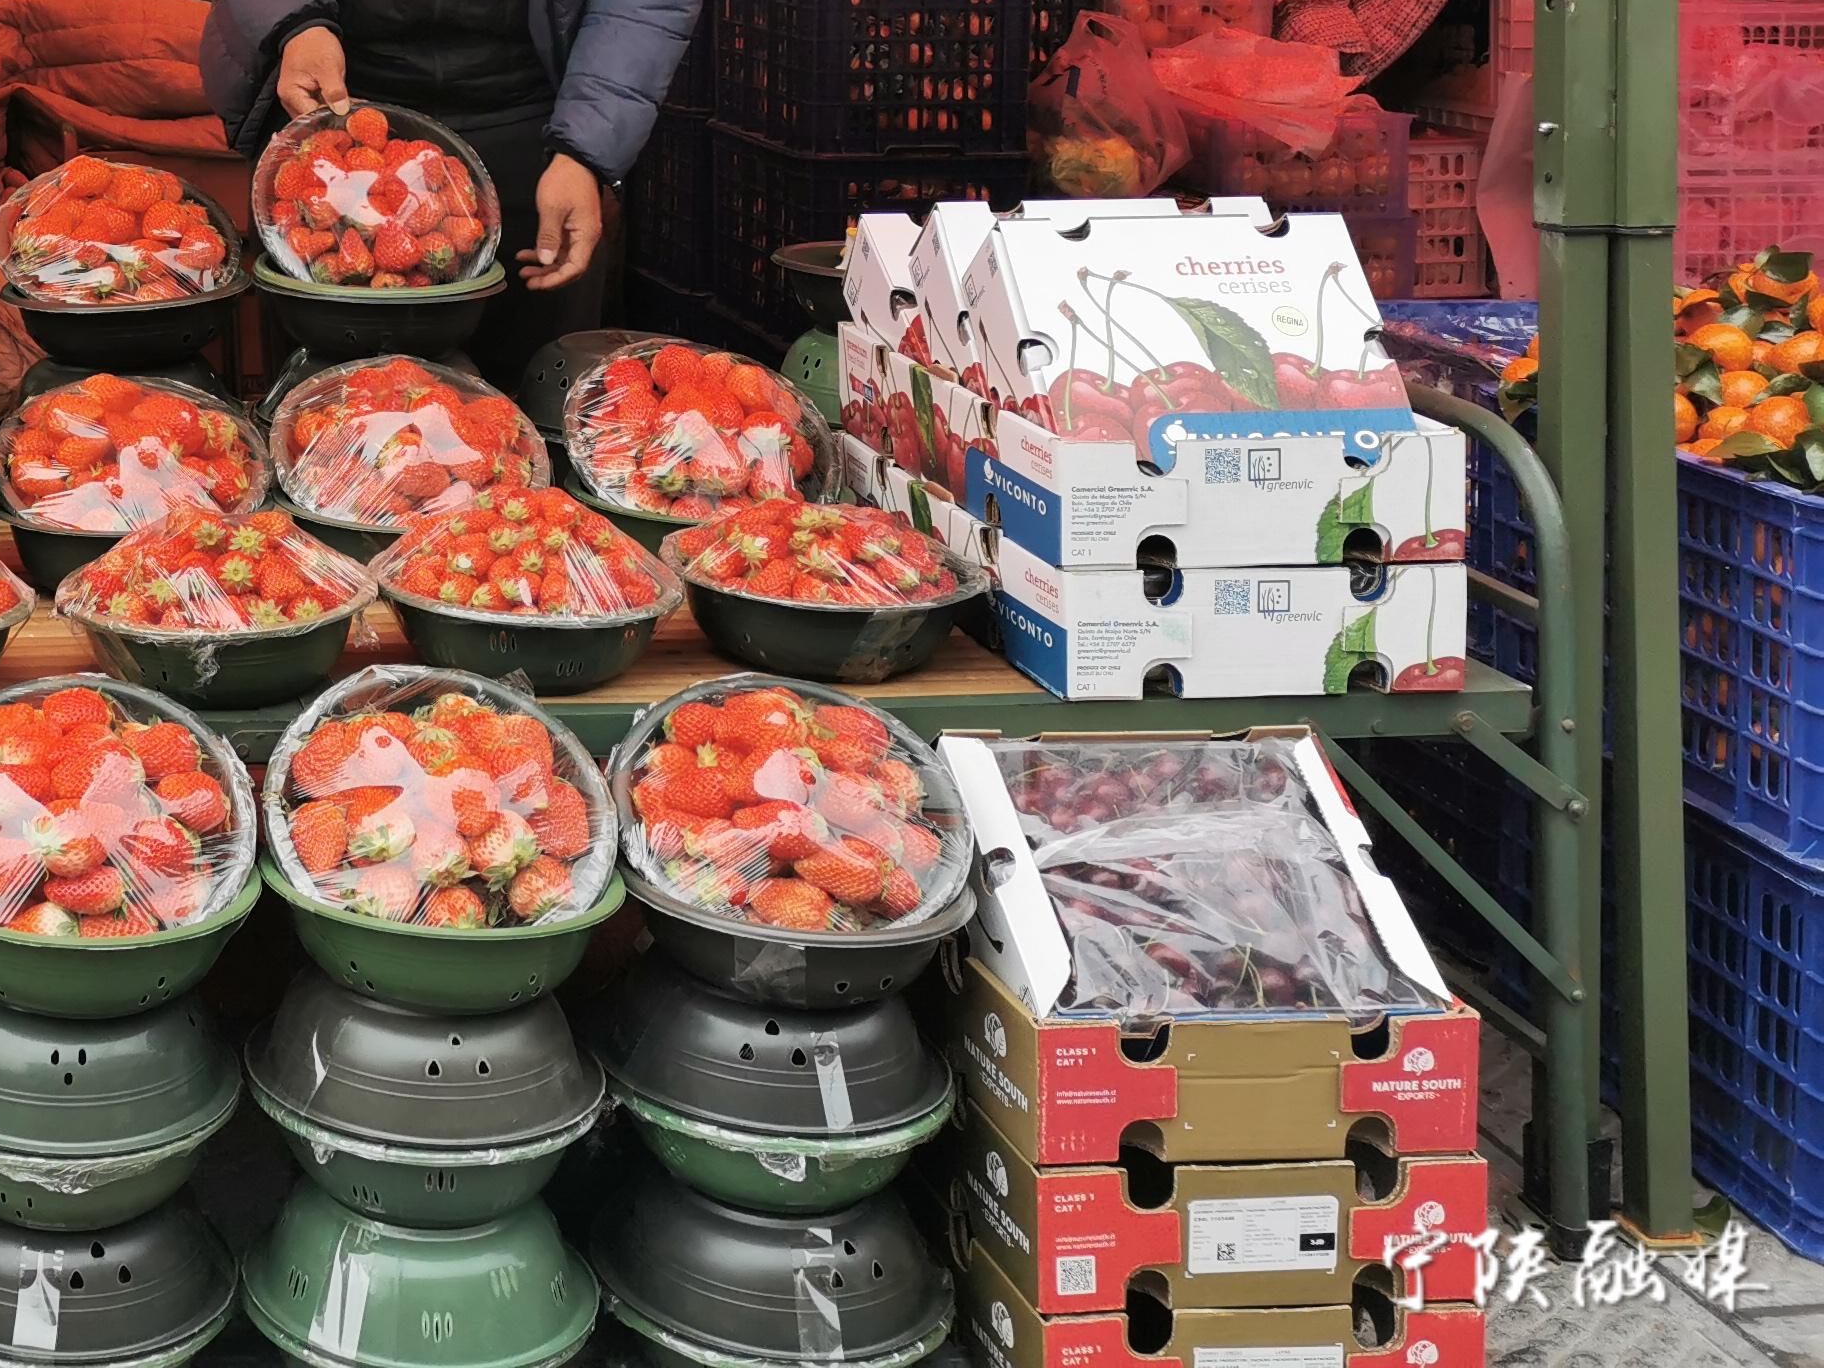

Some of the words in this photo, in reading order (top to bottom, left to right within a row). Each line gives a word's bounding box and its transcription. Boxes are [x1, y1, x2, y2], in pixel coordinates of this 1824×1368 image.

[1175, 256, 1285, 275] cherries
[1218, 278, 1292, 294] cerises
[1276, 314, 1304, 327] REGINA
[1021, 435, 1052, 464] cherries
[1266, 480, 1313, 492] greenvic
[994, 472, 1047, 515] VICONTO
[1024, 568, 1059, 599] cherries
[997, 600, 1053, 648] VICONTO
[1276, 611, 1322, 624] greenvic
[1056, 1048, 1089, 1056] CLASS
[963, 1033, 997, 1080] NATURE
[998, 1071, 1028, 1112] SOUTH
[1372, 1080, 1419, 1092] NATURE
[1421, 1079, 1461, 1090] SOUTH
[1054, 1193, 1087, 1203] CLASS
[967, 1170, 999, 1219] NATURE
[1001, 1210, 1030, 1255] SOUTH
[1054, 1204, 1074, 1213] CAT
[1062, 1346, 1094, 1356] CLASS
[1062, 1356, 1081, 1365] CAT
